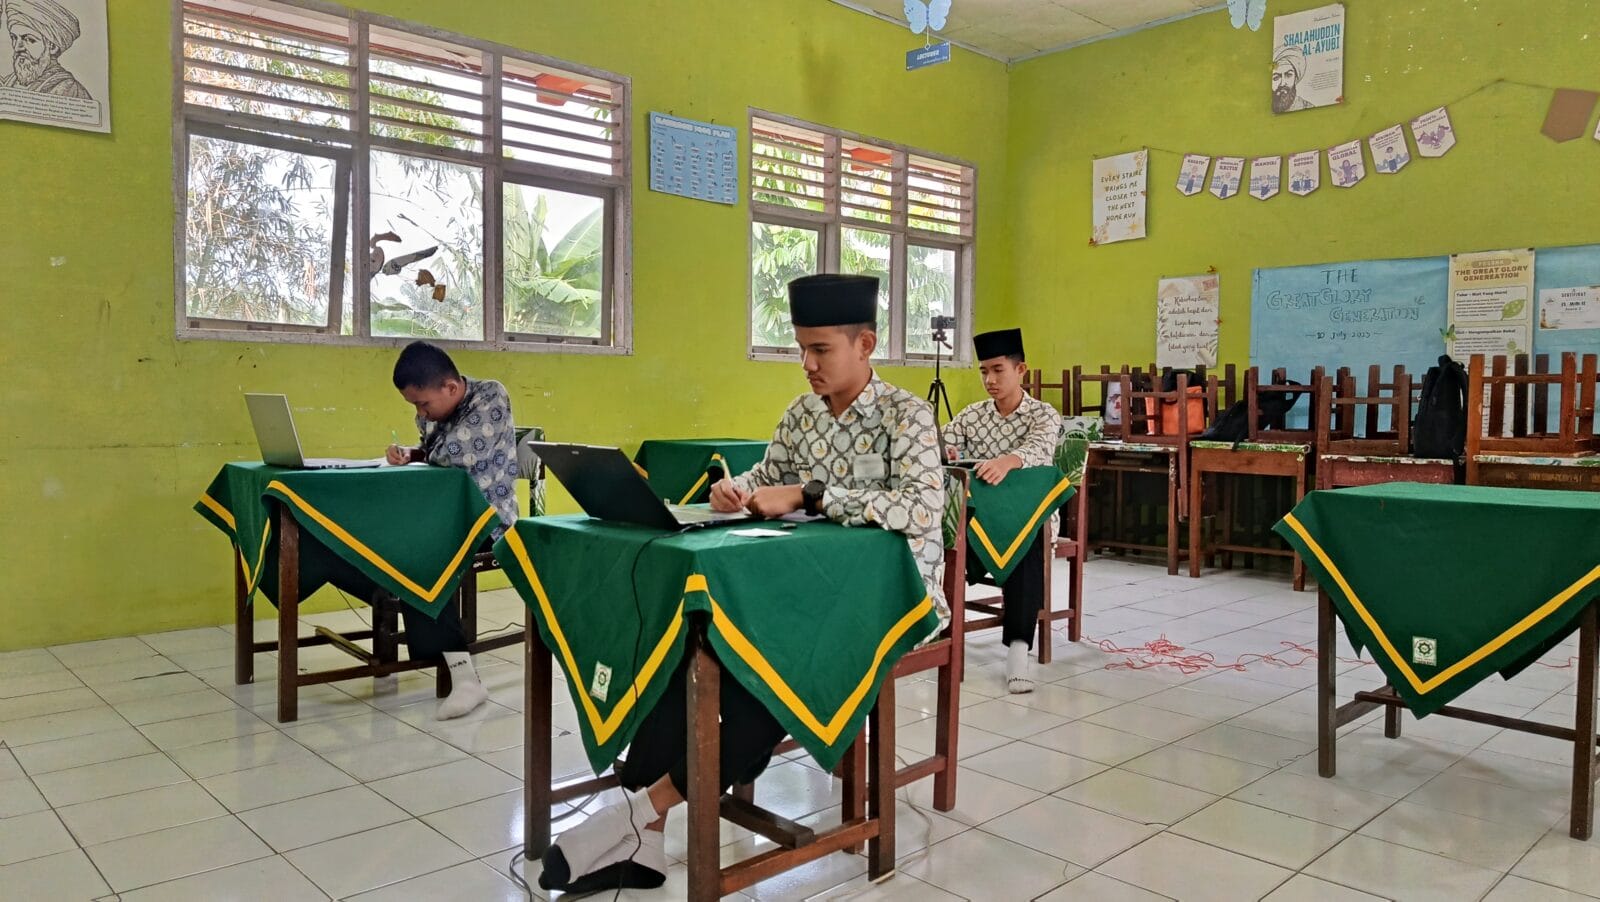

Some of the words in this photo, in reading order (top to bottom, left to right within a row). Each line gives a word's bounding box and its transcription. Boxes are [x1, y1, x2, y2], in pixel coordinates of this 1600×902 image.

[1283, 23, 1340, 47] SHALAHUDDIN
[1302, 36, 1340, 56] AL-AYUBI
[1101, 174, 1120, 183] EVERY
[1105, 193, 1128, 202] CLOSER
[1321, 268, 1359, 285] THE
[1472, 267, 1500, 275] GREAT
[1501, 265, 1529, 273] GLORY
[1266, 290, 1320, 310] GREAT
[1320, 287, 1373, 306] GLORY
[1329, 306, 1420, 322] GENERATION
